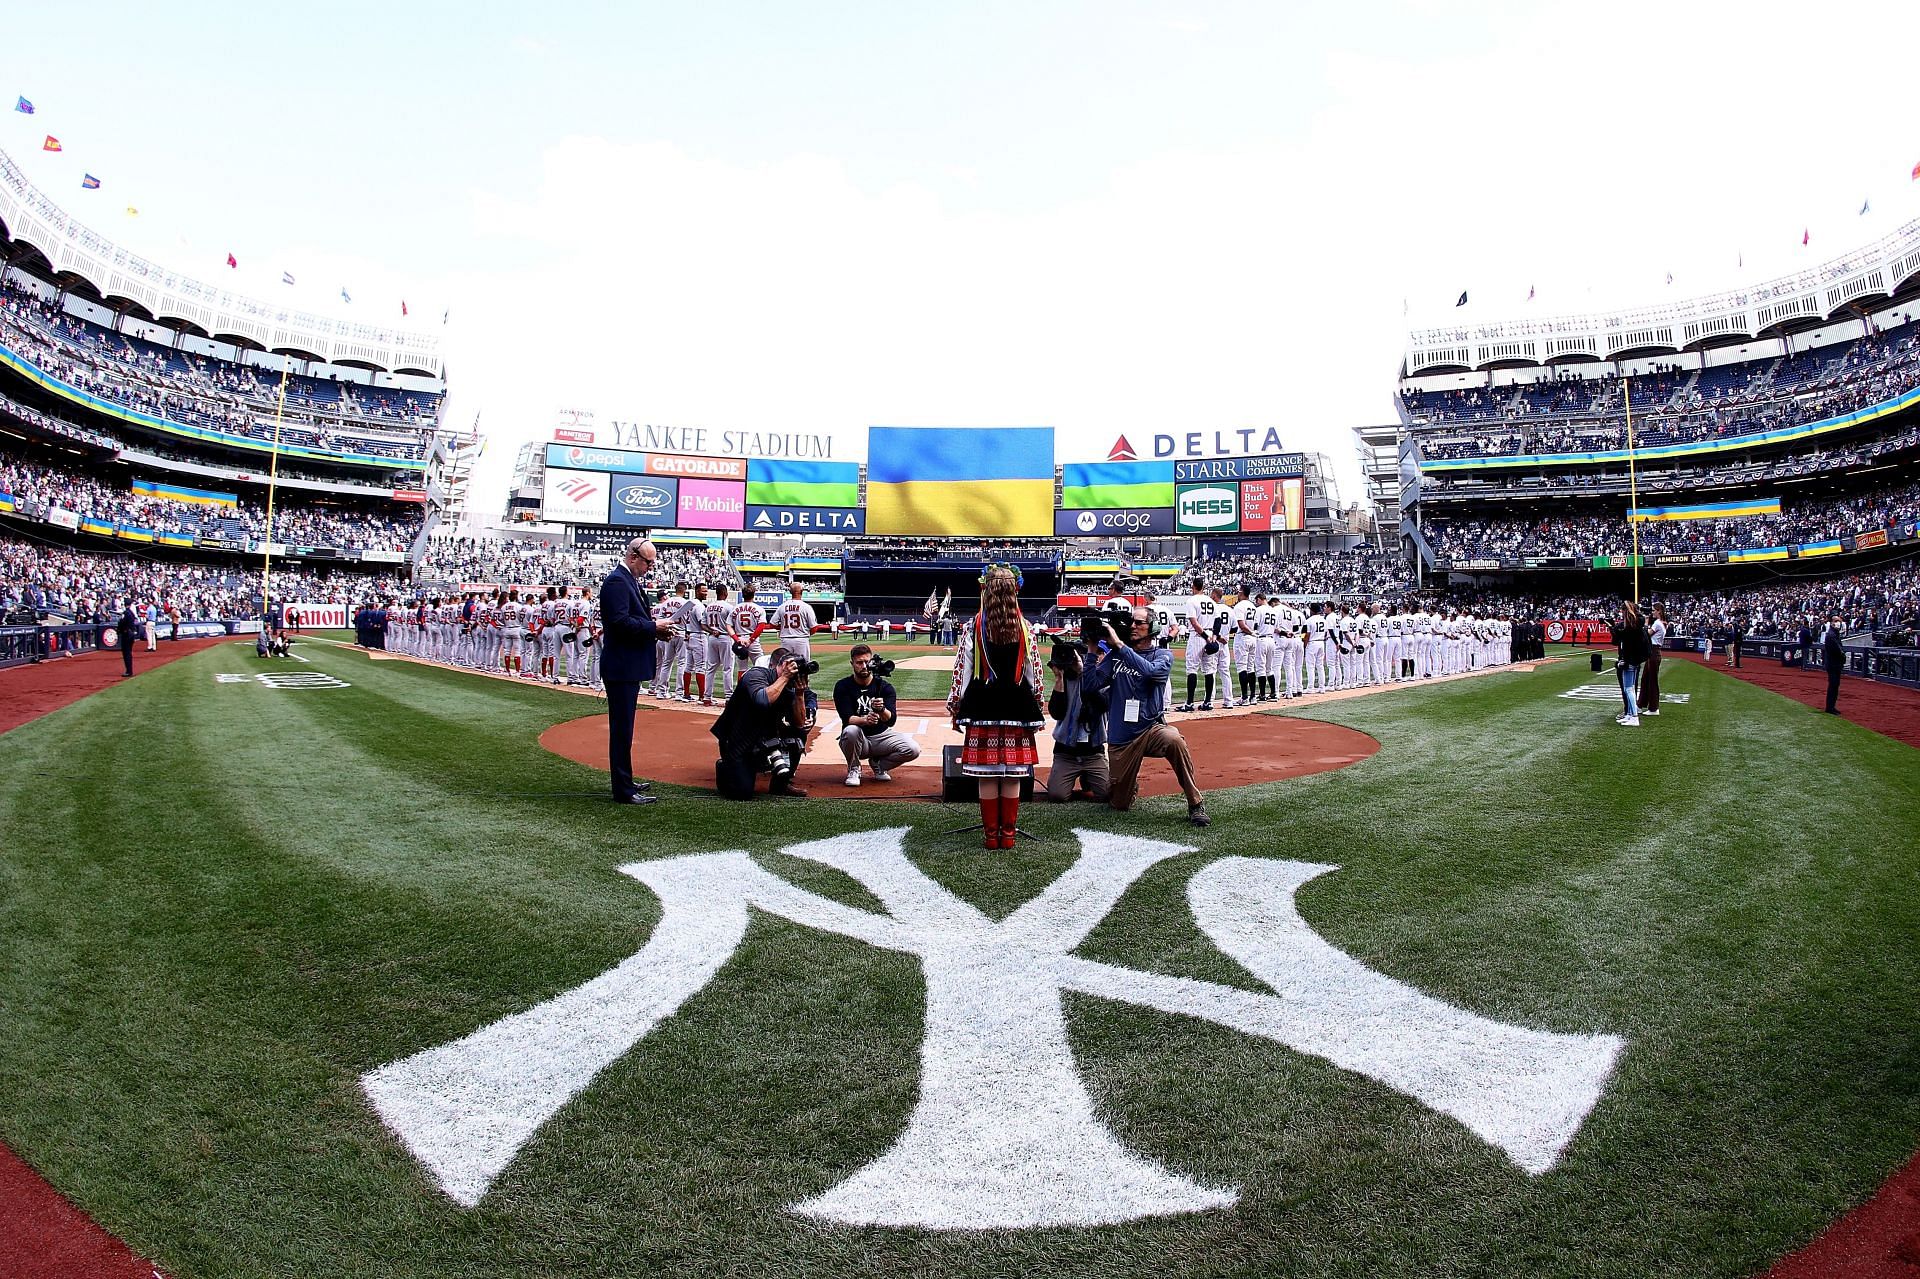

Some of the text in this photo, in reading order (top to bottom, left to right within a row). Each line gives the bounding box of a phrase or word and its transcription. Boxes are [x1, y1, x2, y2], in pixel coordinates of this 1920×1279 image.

[611, 421, 832, 459] YANKEE STADIUM
[1154, 427, 1283, 458] DELTA
[586, 454, 626, 467] pepsi
[652, 457, 740, 476] GATORADE
[1246, 455, 1303, 468] INSURANCE
[1175, 461, 1240, 479] STARR
[1246, 465, 1303, 476] COMPANIES
[1243, 484, 1265, 493] This
[625, 487, 662, 506] Ford
[1243, 493, 1269, 502] Bud's
[695, 497, 744, 513] Mobile
[1182, 500, 1233, 516] HESS
[1244, 502, 1260, 511] For
[780, 511, 858, 528] DELTA
[1102, 510, 1151, 533] edge
[1243, 511, 1264, 520] You.
[1452, 559, 1500, 568] Parts Authority
[1706, 554, 1715, 562] PM
[753, 595, 778, 605] coupa
[284, 606, 345, 626] Canon
[1200, 602, 1214, 616] 99
[1246, 607, 1257, 621] 27
[1283, 609, 1293, 621] 13
[708, 613, 720, 628] 11
[739, 613, 751, 628] 5
[783, 613, 801, 629] 13
[1158, 611, 1168, 626] 8
[1220, 611, 1229, 625] 8
[1264, 612, 1276, 626] 26
[1315, 621, 1325, 633] 12
[1565, 622, 1610, 633] FW. WE
[313, 827, 1625, 1231] NY
